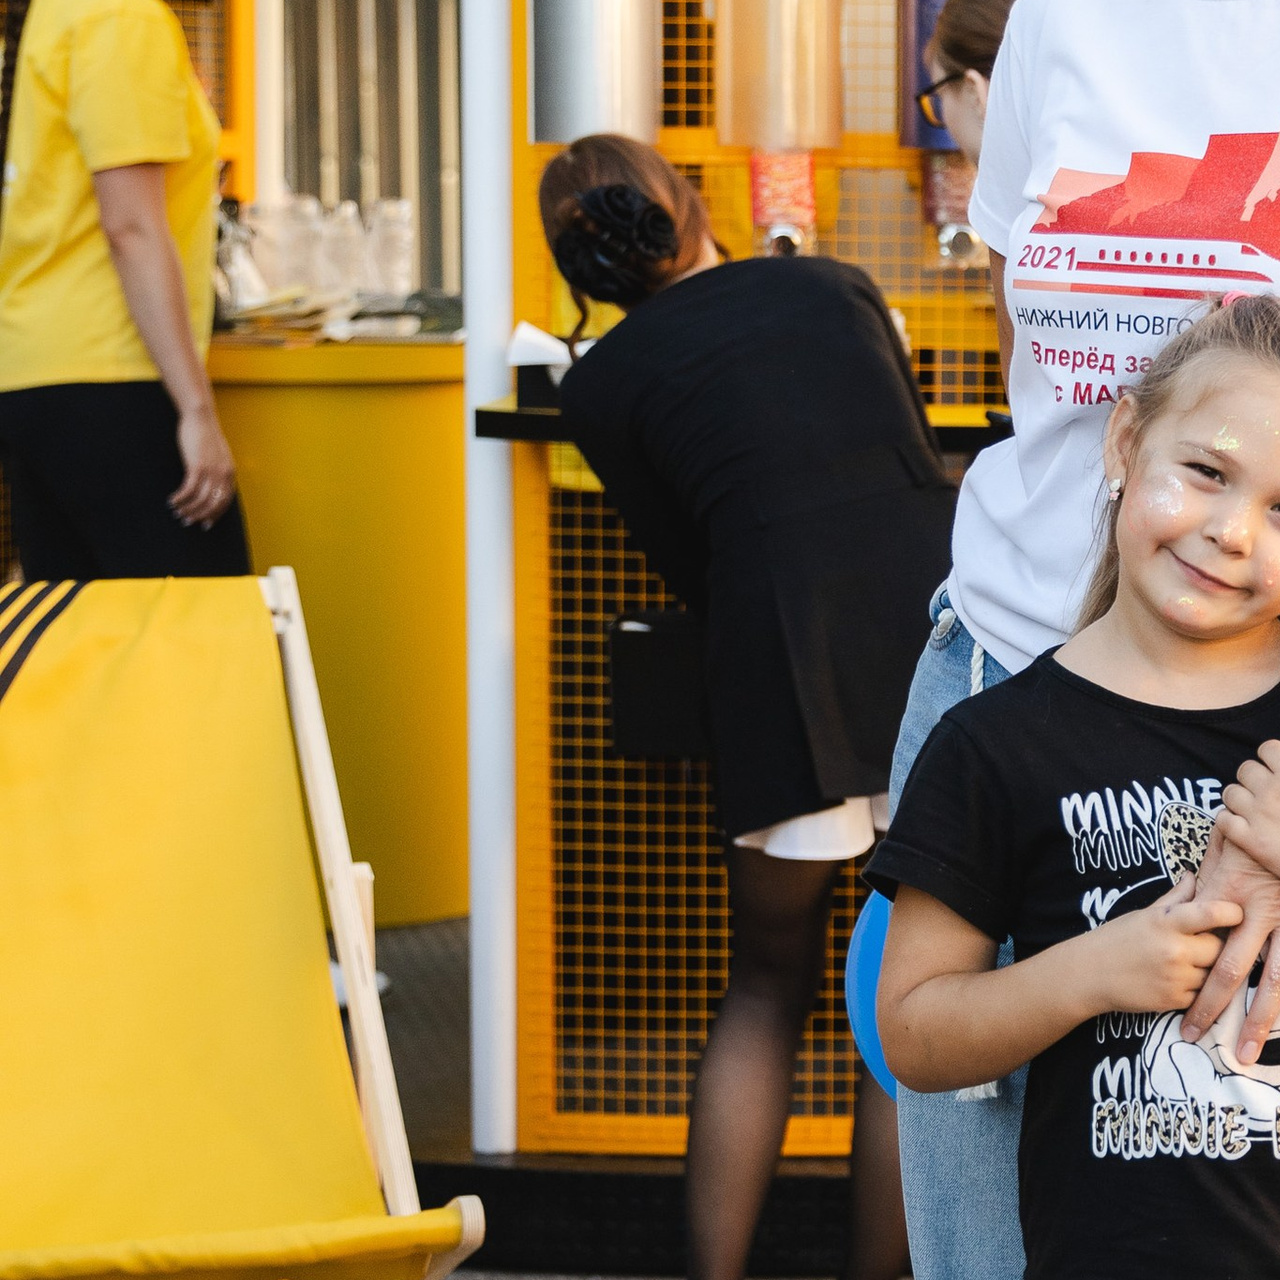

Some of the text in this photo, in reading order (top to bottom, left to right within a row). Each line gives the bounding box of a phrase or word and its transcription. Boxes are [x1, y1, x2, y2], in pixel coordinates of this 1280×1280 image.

[1017, 244, 1077, 271] 2021
[1015, 306, 1194, 336] НИЖНИЙ НОВГО
[1031, 340, 1116, 376] Вперёд
[1091, 1095, 1251, 1161] MINNIE
